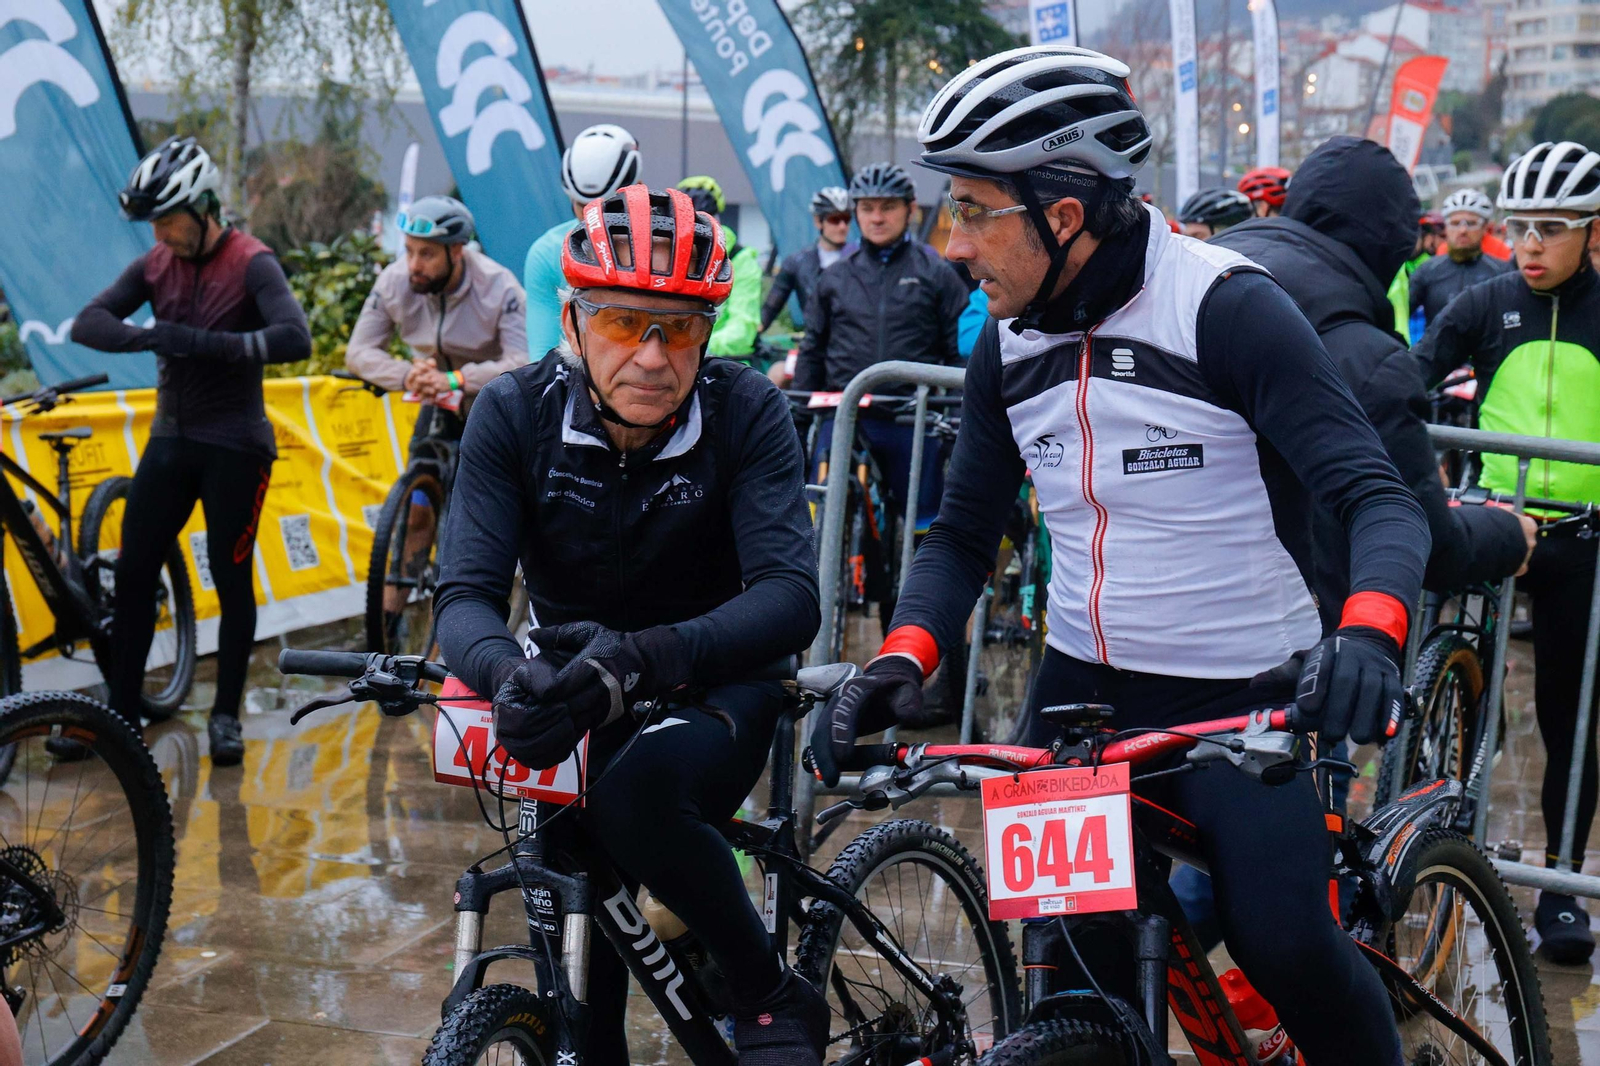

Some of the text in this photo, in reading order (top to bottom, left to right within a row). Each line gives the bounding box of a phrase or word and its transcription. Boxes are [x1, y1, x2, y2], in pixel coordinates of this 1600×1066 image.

[1048, 129, 1080, 149] ABUS
[1138, 448, 1188, 460] Bicicletas
[1127, 457, 1200, 472] GONZALO AGUIAR
[991, 788, 1000, 801] A
[1050, 774, 1119, 792] BIKEDADA
[1001, 815, 1114, 892] 644
